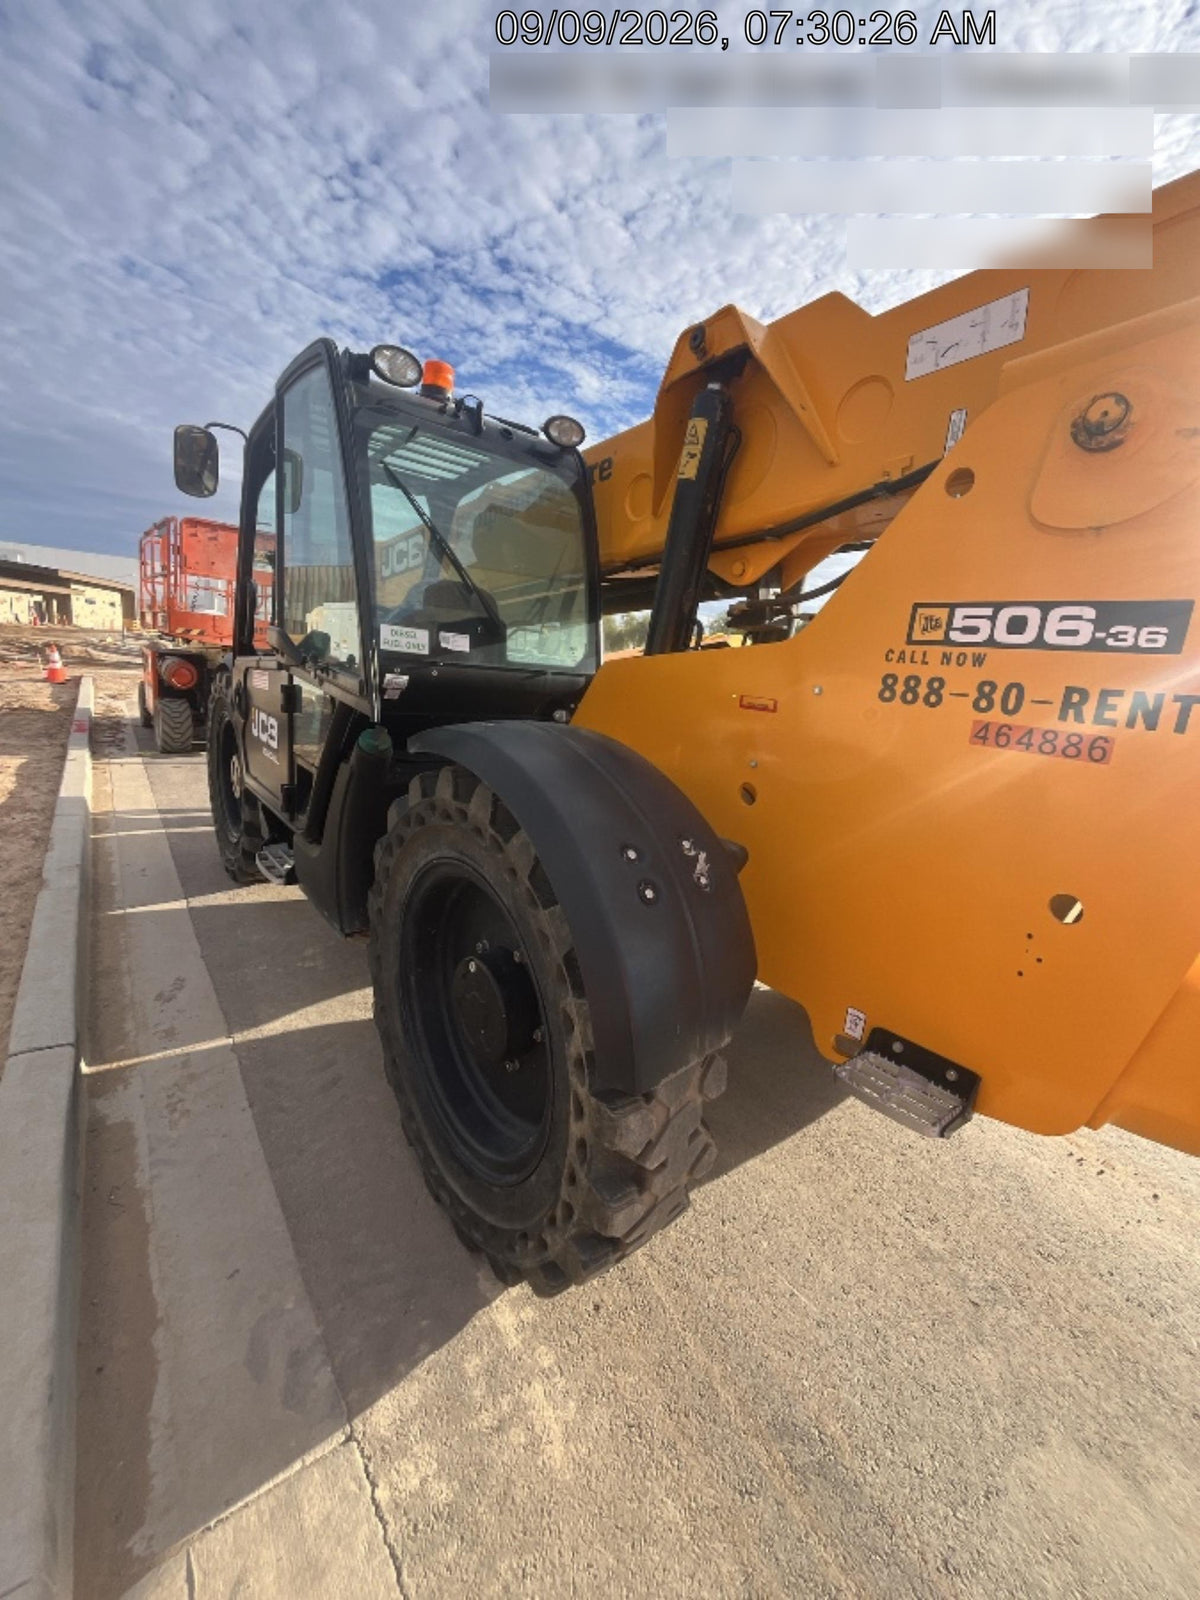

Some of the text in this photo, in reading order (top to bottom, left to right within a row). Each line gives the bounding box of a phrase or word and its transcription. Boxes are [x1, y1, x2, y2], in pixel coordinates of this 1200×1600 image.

[948, 605, 1169, 649] 506-36
[885, 648, 988, 668] CALL NOW
[252, 706, 279, 750] JCB
[973, 720, 1112, 763] 464886
